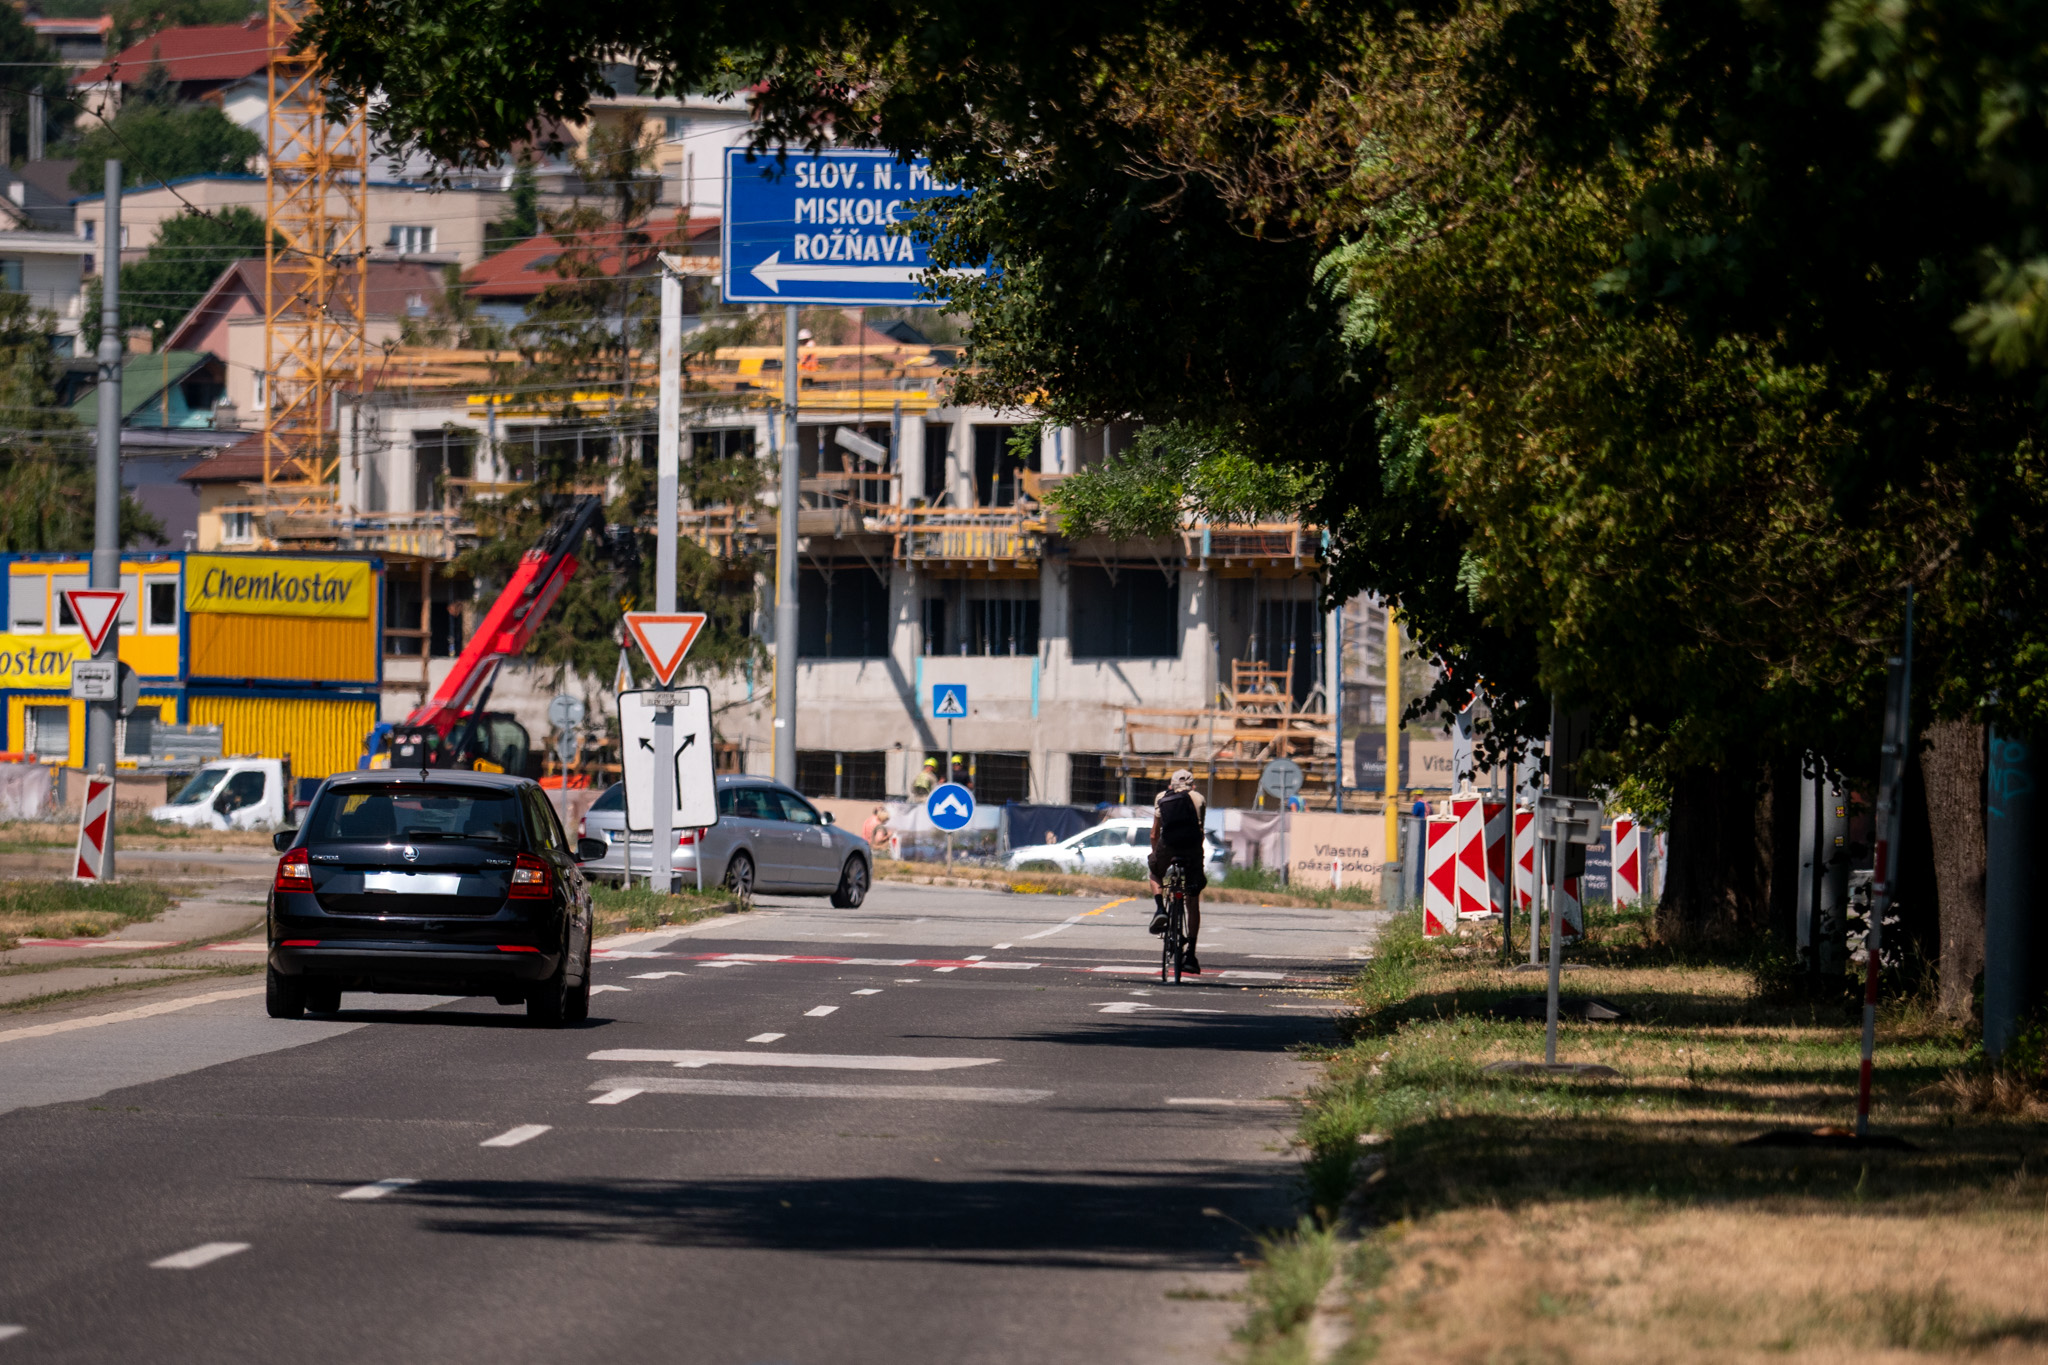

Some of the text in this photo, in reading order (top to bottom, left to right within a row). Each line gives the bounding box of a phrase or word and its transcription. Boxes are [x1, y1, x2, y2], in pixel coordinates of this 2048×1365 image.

[794, 162, 865, 189] SLOV.
[873, 162, 902, 190] N.
[794, 197, 900, 225] MISKOLC
[794, 228, 914, 262] ROŽŇAVA
[203, 567, 352, 604] Chemkostav
[1314, 844, 1369, 858] Vlastná
